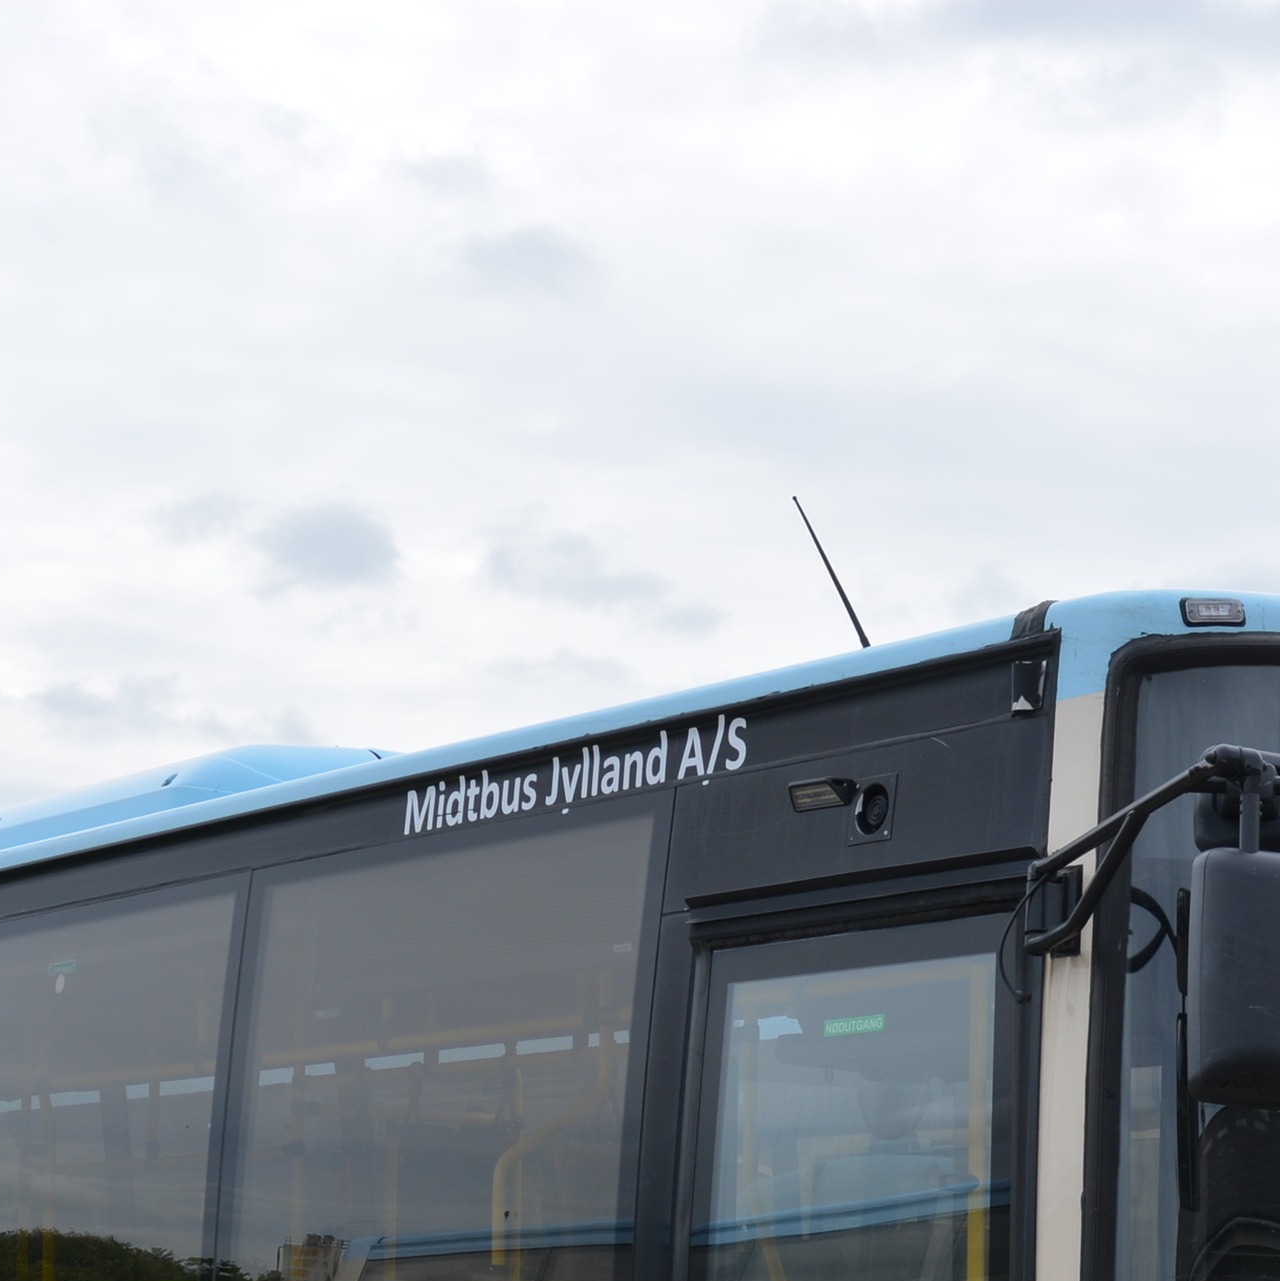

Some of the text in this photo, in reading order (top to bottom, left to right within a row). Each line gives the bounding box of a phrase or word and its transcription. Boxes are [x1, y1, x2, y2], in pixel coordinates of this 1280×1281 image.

[403, 713, 748, 836] Midtbus Jylland A/S
